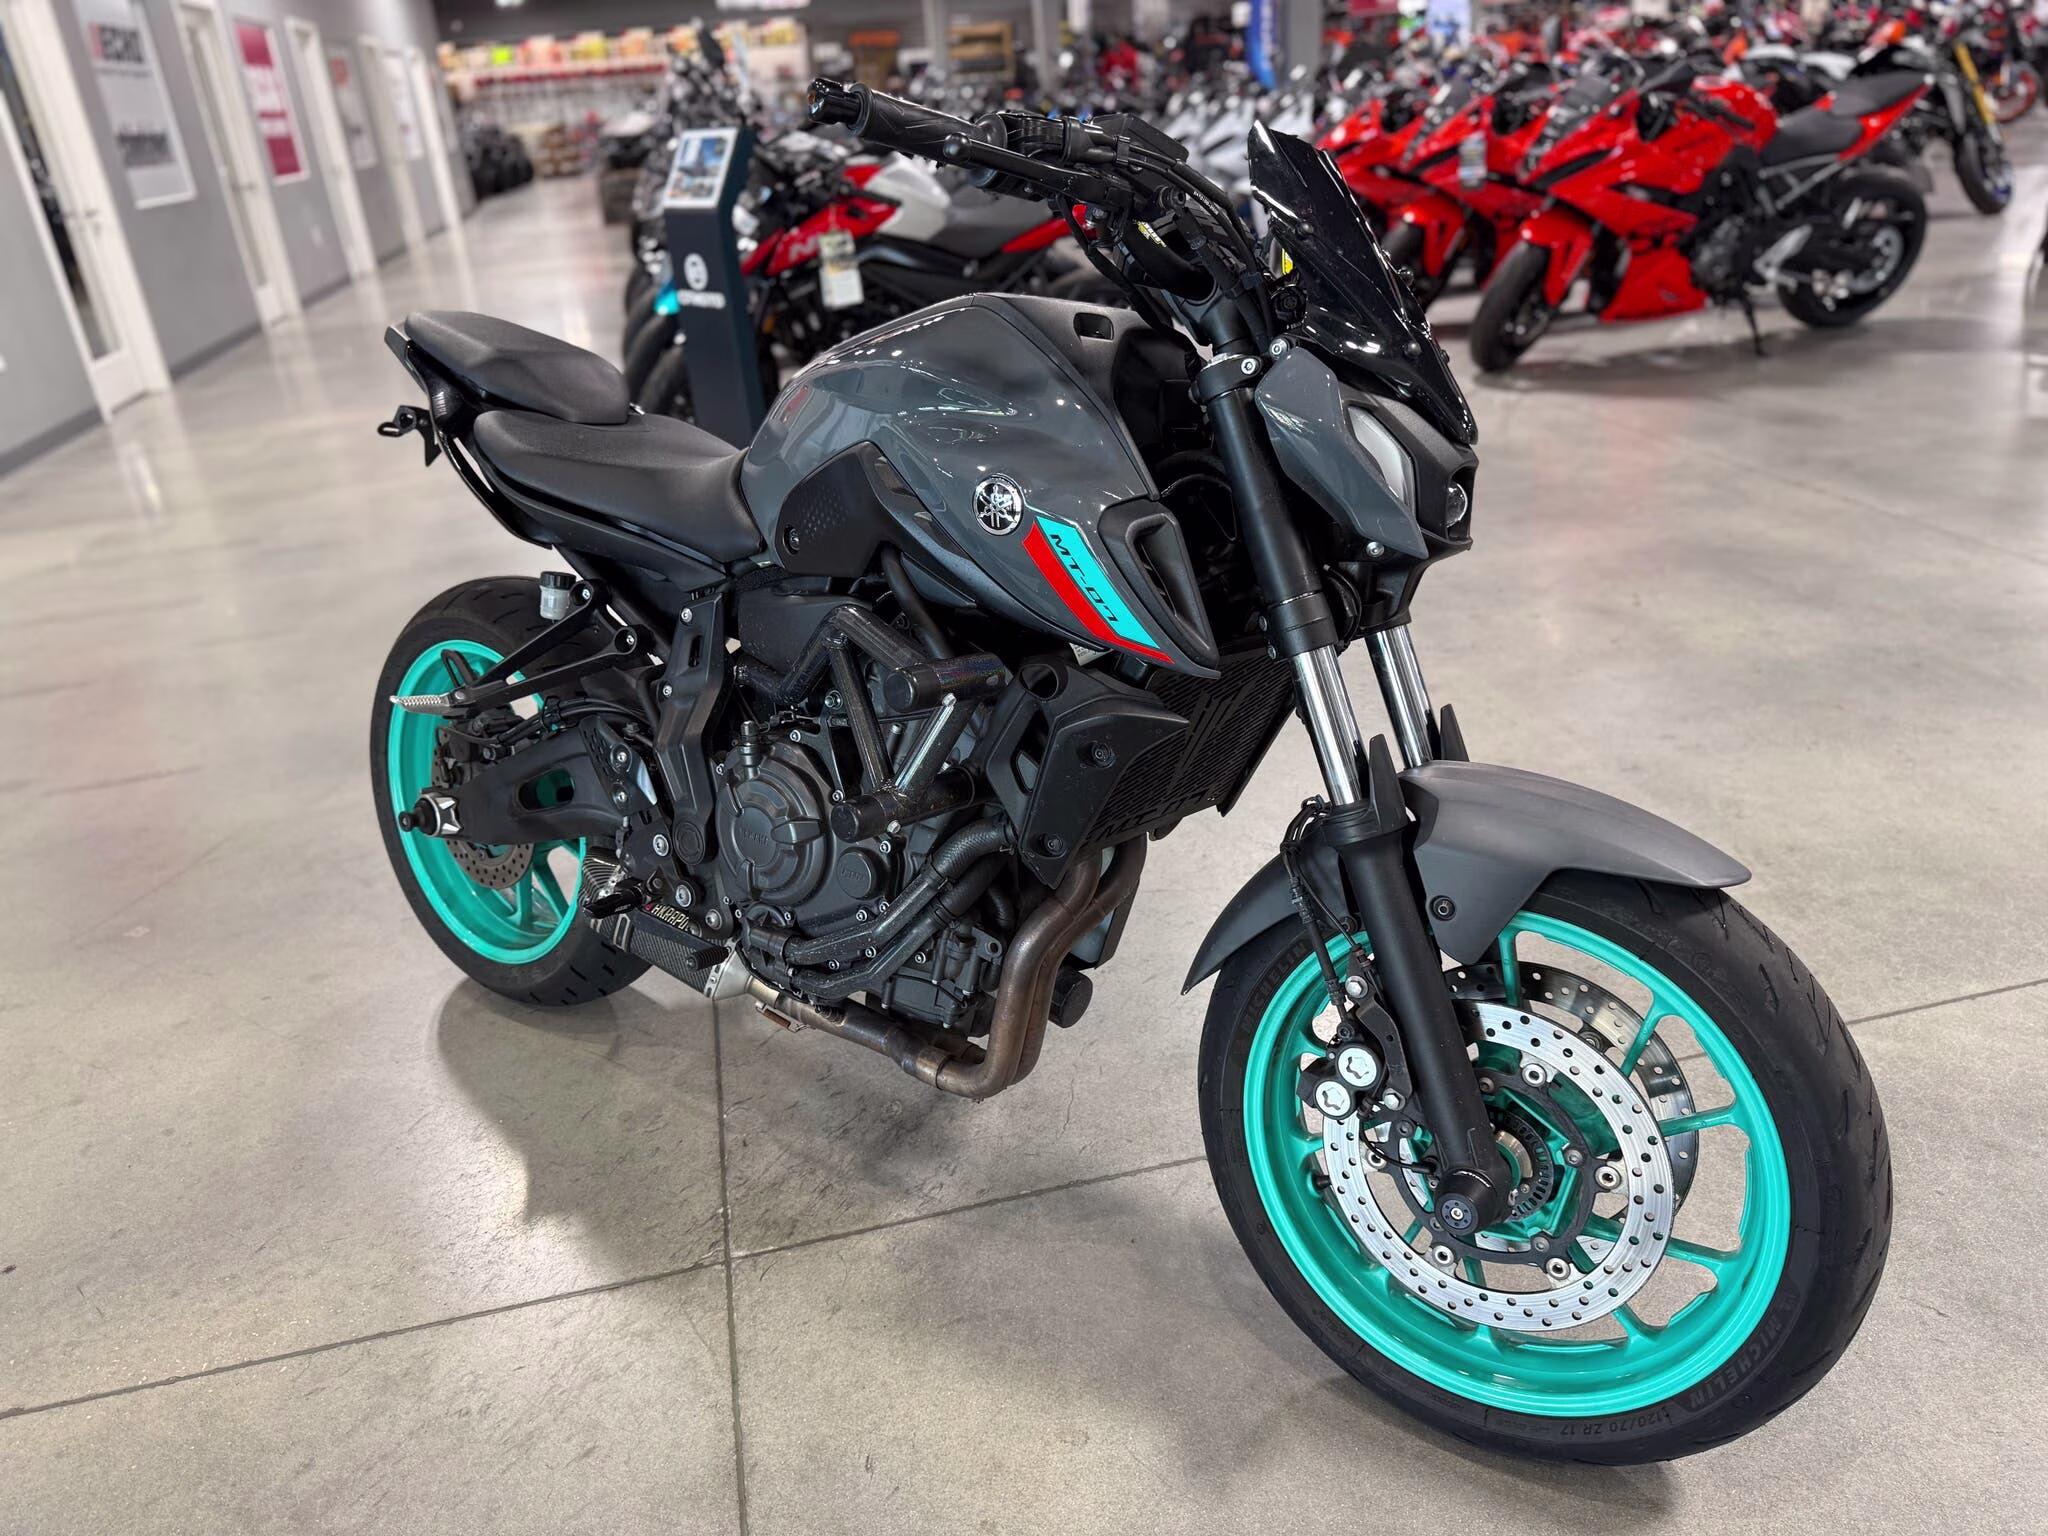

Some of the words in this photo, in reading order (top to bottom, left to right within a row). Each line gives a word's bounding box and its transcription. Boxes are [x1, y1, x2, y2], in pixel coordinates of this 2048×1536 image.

[1050, 534, 1120, 623] MT-07
[651, 903, 690, 931] AKRAPO
[1239, 941, 1308, 1034] MICHELIN
[1689, 1314, 1783, 1409] MICHELIN
[1560, 1423, 1576, 1436] 17
[1583, 1423, 1603, 1436] ZR
[1608, 1412, 1664, 1433] 120/70
